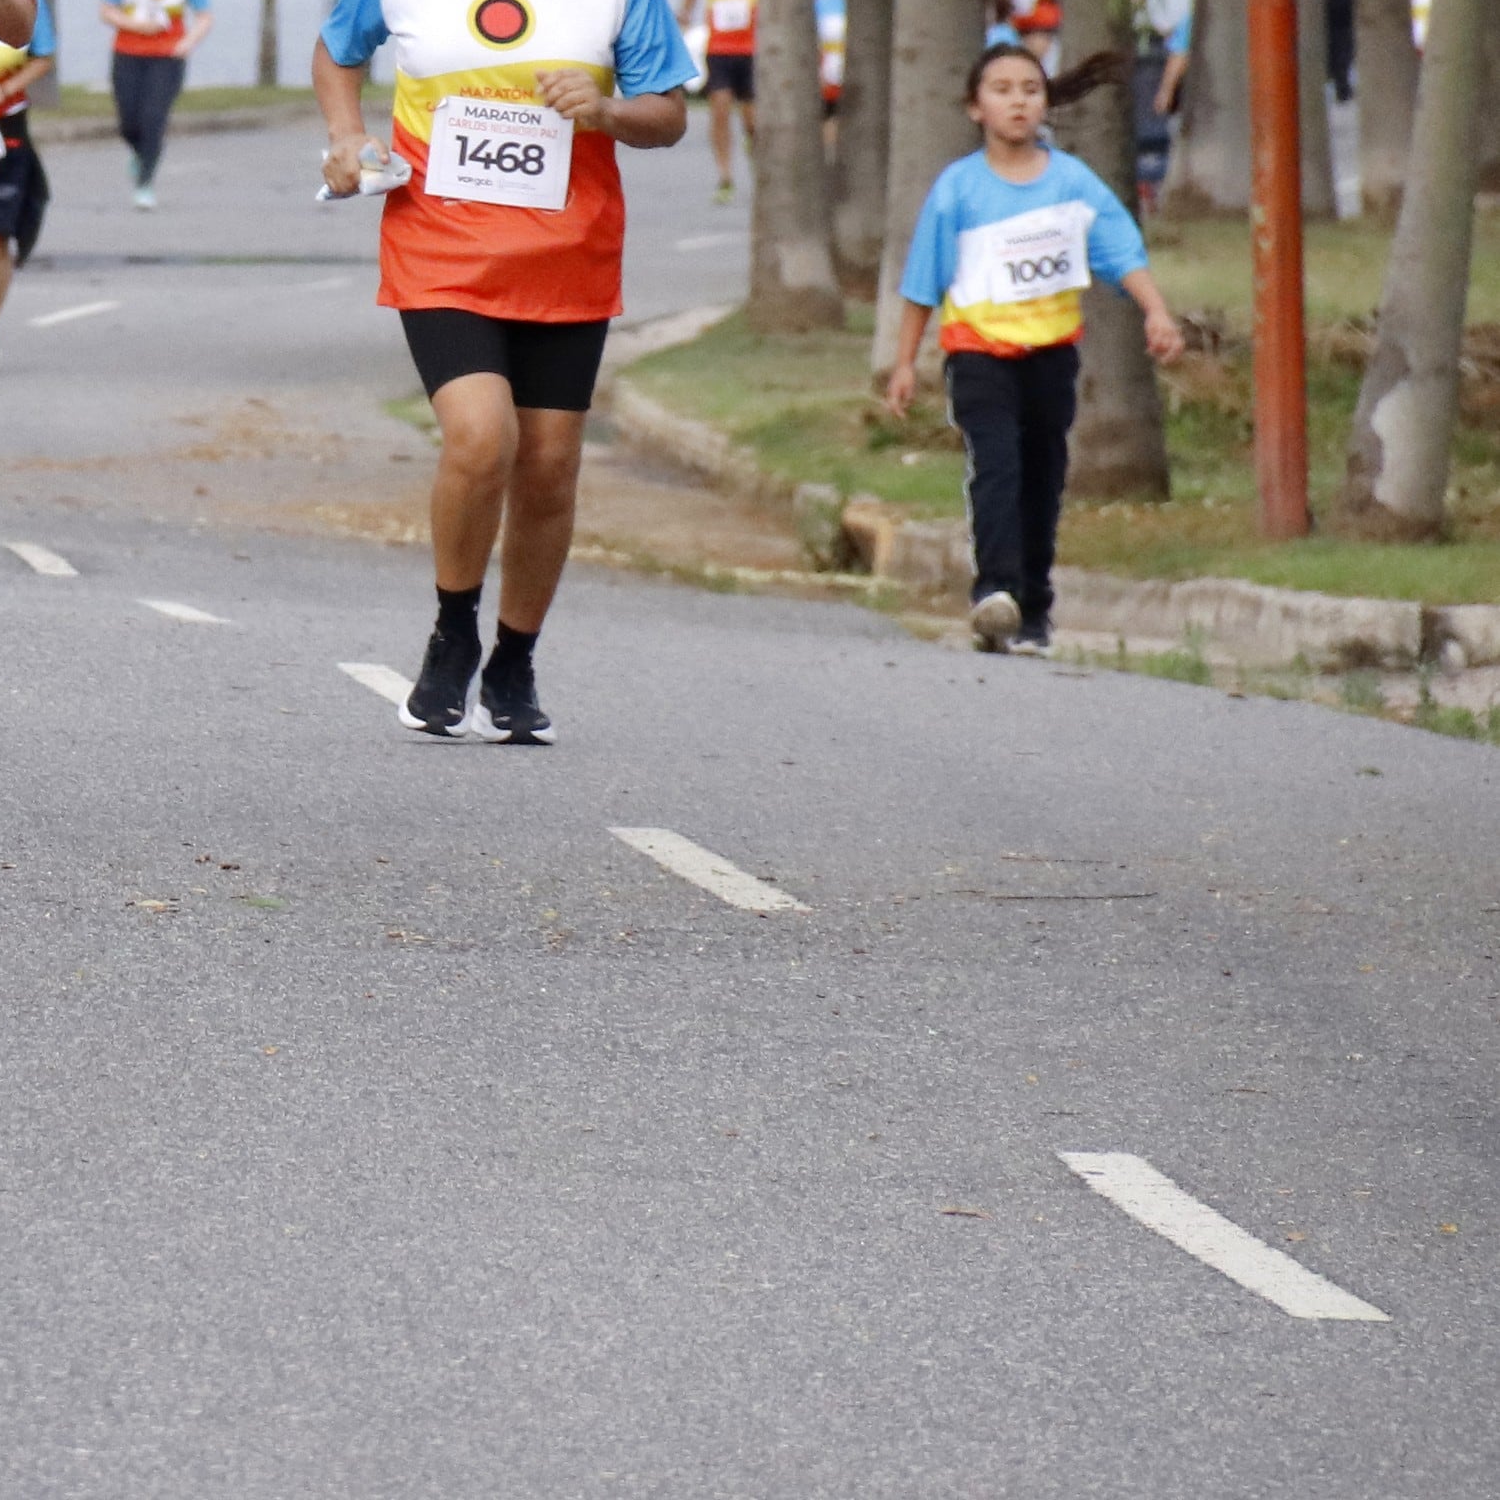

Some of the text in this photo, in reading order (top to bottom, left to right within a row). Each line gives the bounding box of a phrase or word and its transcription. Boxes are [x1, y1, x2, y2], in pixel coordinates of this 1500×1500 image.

[448, 117, 488, 132] CARLOS
[464, 105, 542, 126] MARATÓN
[455, 134, 546, 176] 1468
[1003, 249, 1070, 285] 1006
